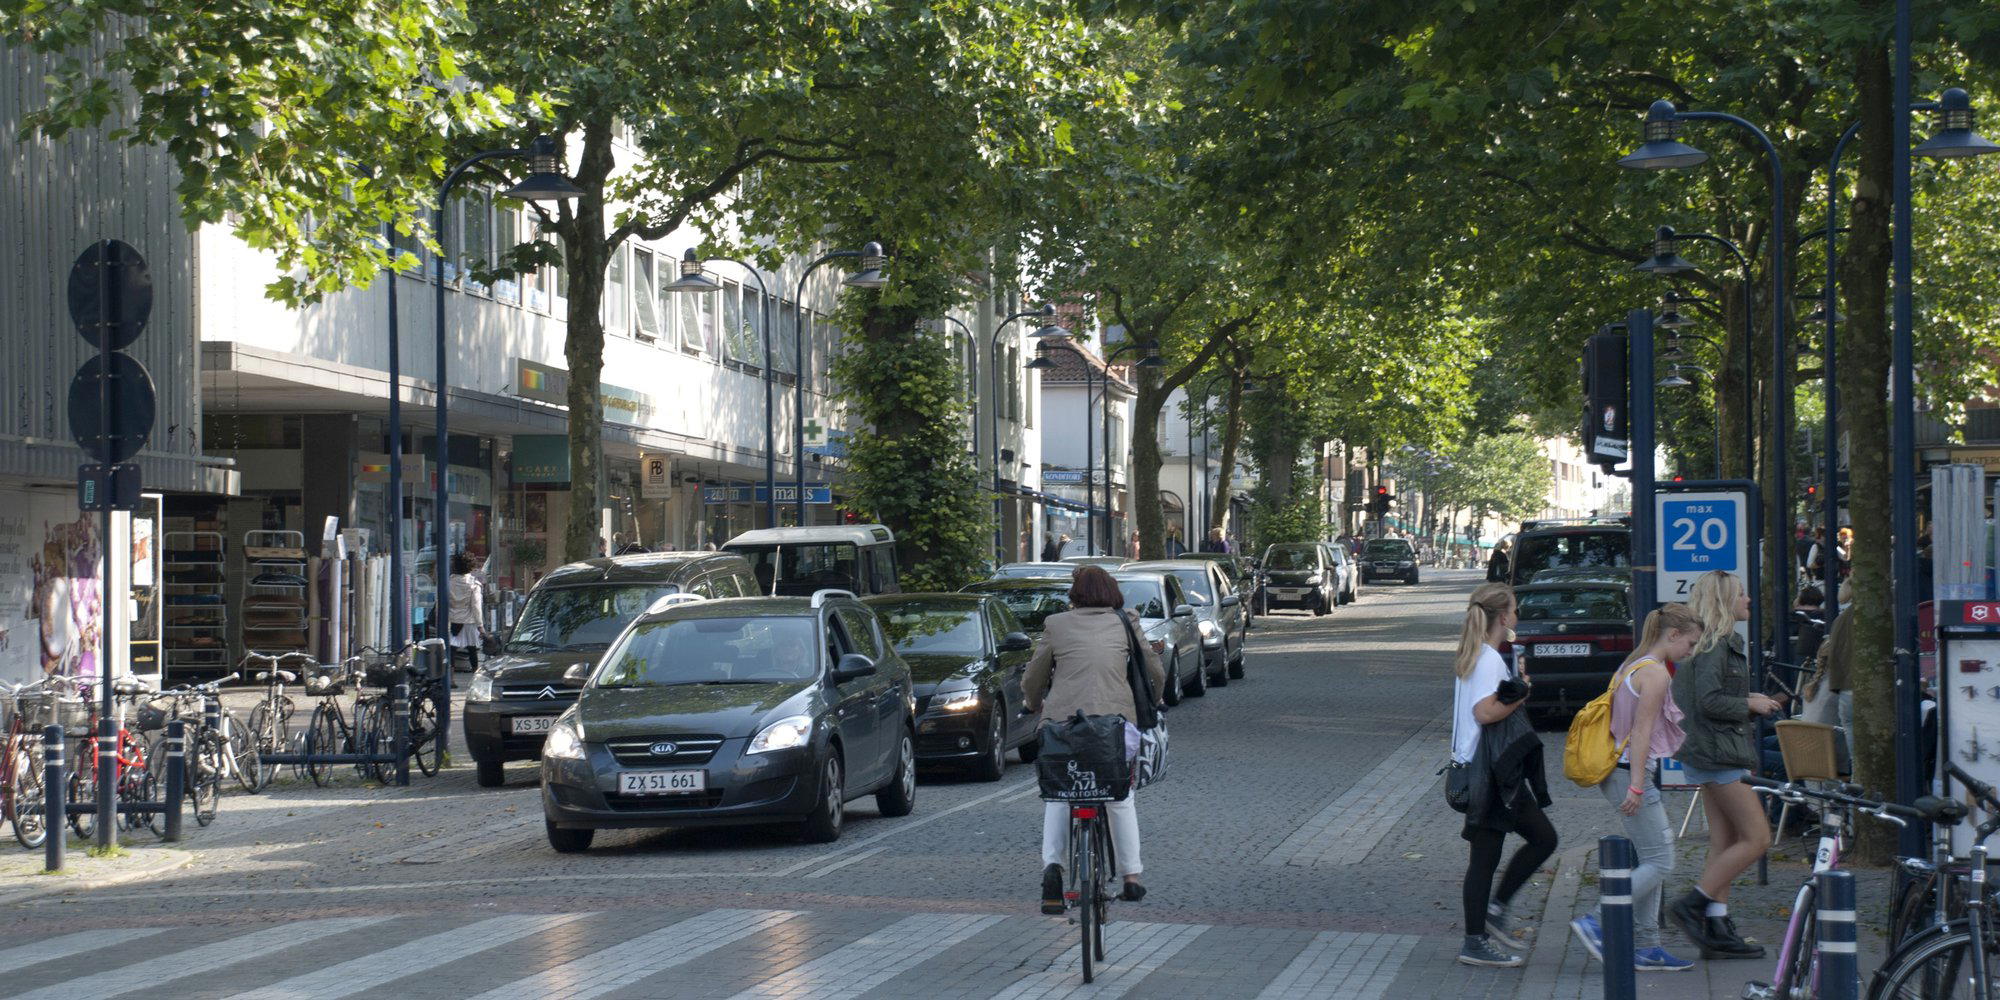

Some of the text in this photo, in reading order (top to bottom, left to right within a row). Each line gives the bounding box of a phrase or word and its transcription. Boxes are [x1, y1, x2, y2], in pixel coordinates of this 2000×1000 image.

[774, 487, 814, 500] mas
[1686, 505, 1712, 513] max
[1672, 517, 1728, 550] 20
[1691, 553, 1709, 562] km
[1536, 645, 1588, 654] SX 36 127
[515, 719, 532, 731] XS
[536, 718, 549, 730] 30
[654, 744, 672, 752] KIA
[628, 774, 695, 790] ZX 51 661
